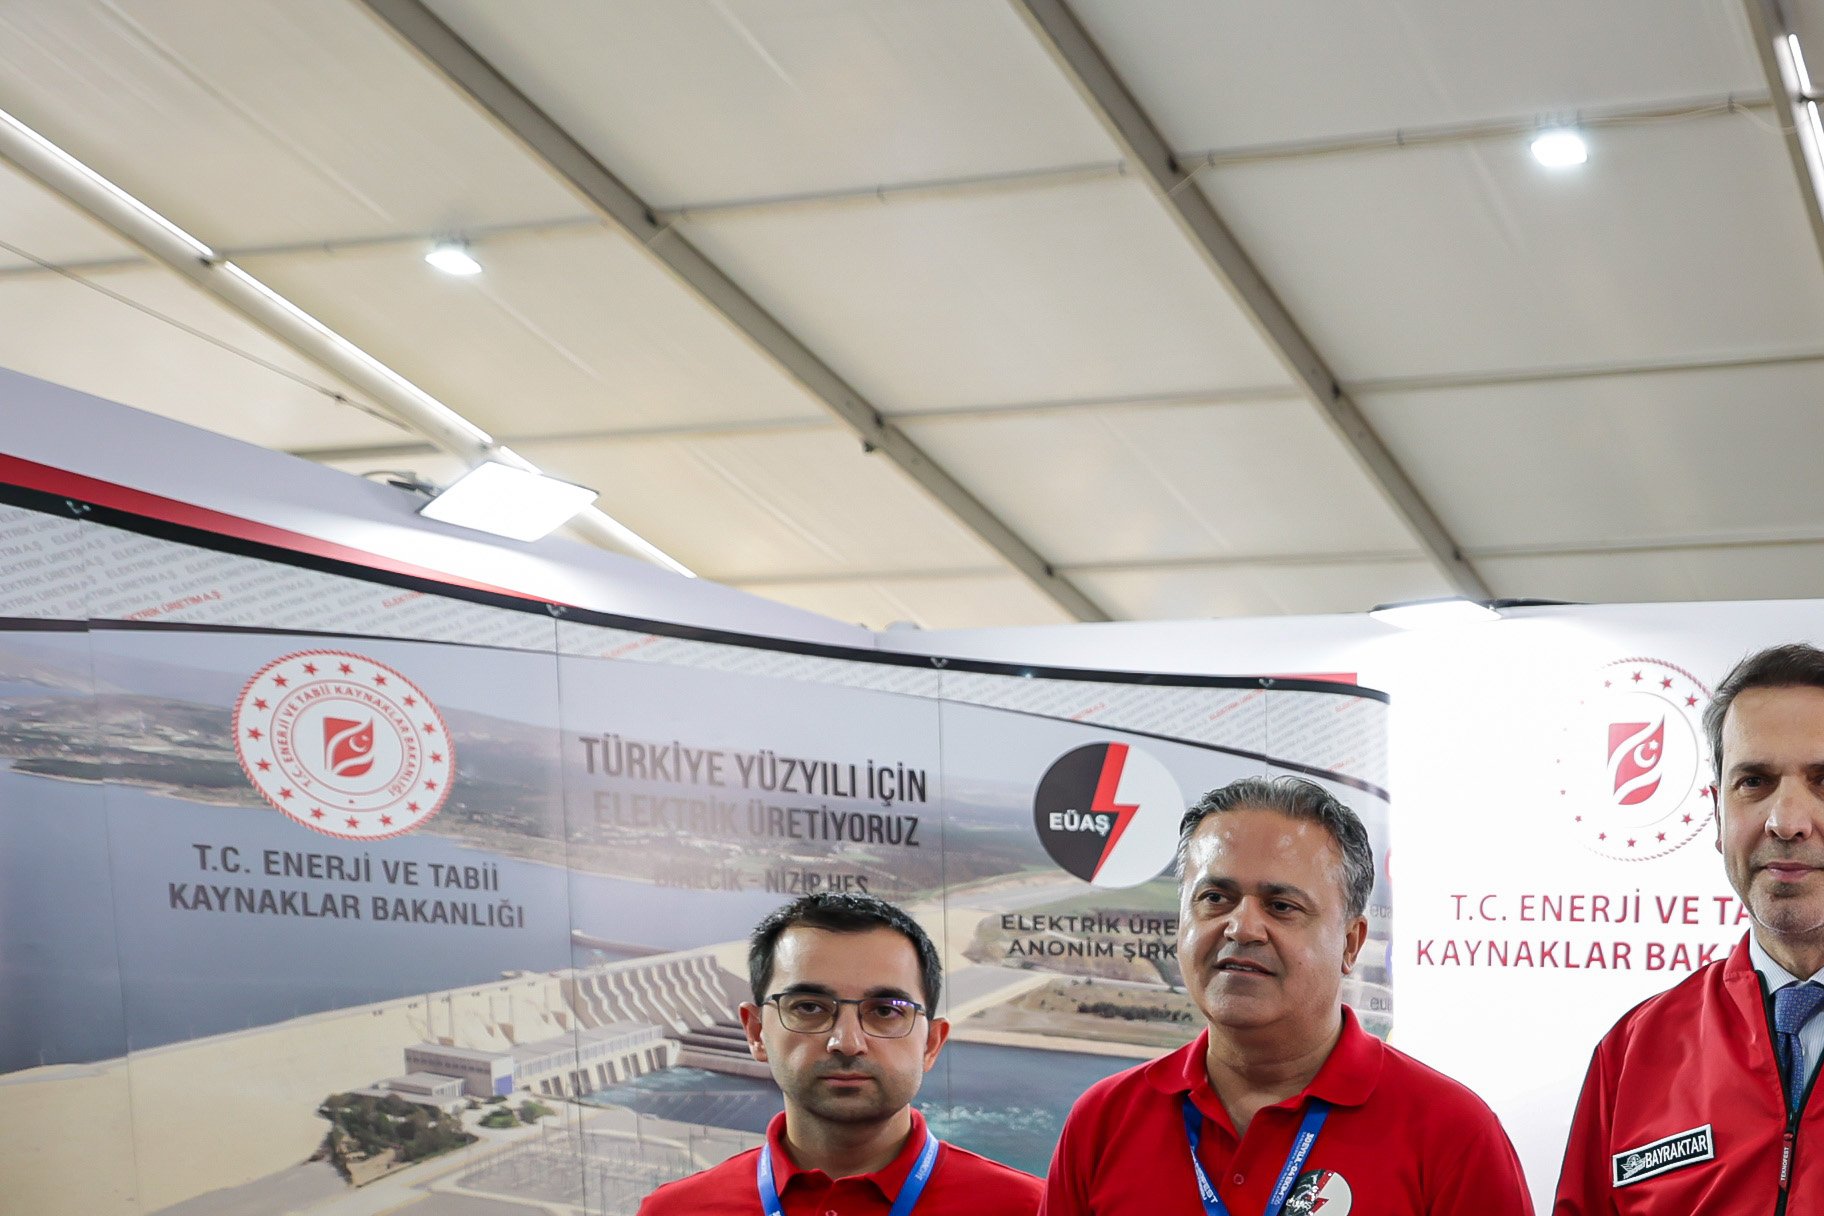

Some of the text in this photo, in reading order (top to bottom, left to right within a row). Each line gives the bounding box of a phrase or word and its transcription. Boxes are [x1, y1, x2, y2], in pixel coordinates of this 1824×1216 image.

[579, 733, 927, 806] TÜRKİYE YÜZYILI İÇİN
[750, 800, 920, 847] ÜRETİYORUZ
[1049, 811, 1111, 838] EÜAŞ
[192, 844, 499, 891] T.C. ENERJİ VE TABİİ
[168, 882, 525, 929] KAYNAKLAR BAKANLIĞI
[1451, 894, 1507, 921] T.C.
[1520, 888, 1640, 923] ENERJİ
[1655, 896, 1699, 925] VE
[1001, 912, 1180, 935] ELEKTRİK ÜRE
[1007, 937, 1178, 964] ANONİM ŞİRK
[1417, 939, 1632, 970] KAYNAKLAR
[1645, 1135, 1707, 1169] BAYRAKTAR
[1780, 1146, 1790, 1181] TEKNOFEST
